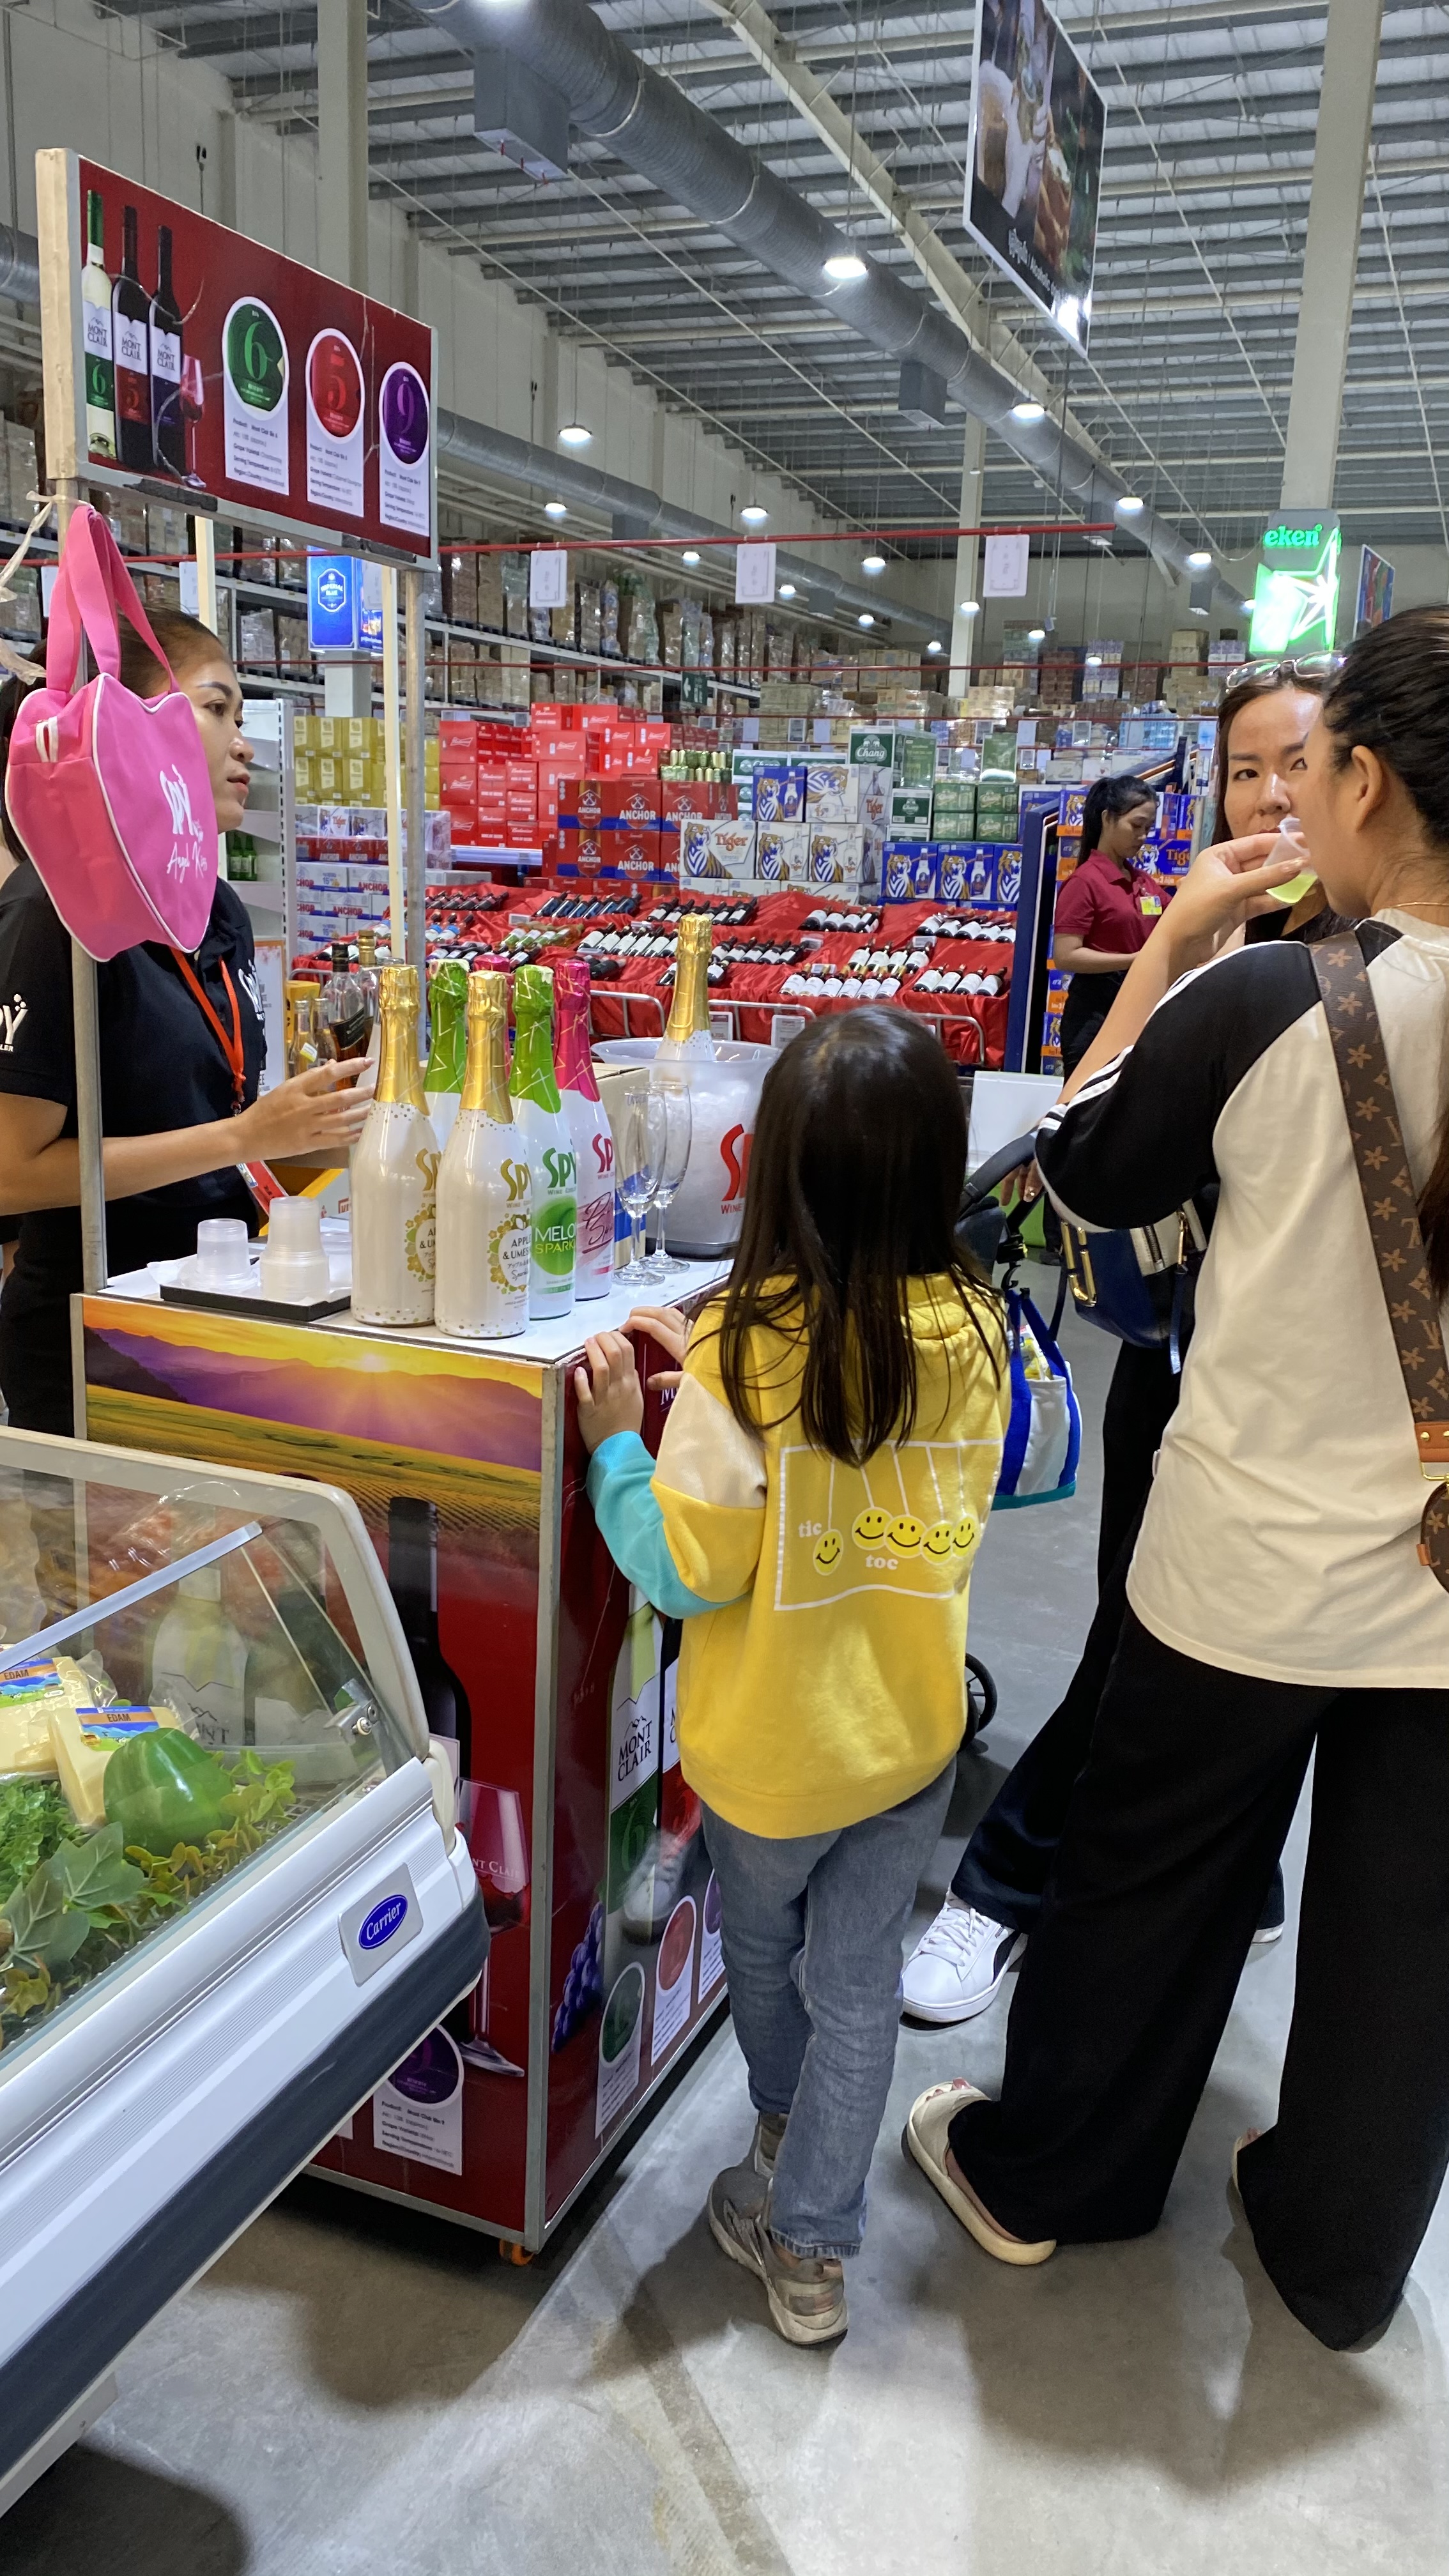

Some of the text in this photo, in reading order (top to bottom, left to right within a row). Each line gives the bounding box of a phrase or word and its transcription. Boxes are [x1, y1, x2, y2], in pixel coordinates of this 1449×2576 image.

[88, 324, 107, 339] MONT
[88, 332, 107, 347] CLAIR
[121, 337, 141, 352] MONT
[121, 346, 141, 361] CLAIR
[157, 349, 176, 362] MONT
[245, 321, 267, 381] 6
[157, 357, 176, 371] CLAIR
[92, 364, 106, 395] 6
[397, 383, 414, 434] 9
[857, 747, 885, 758] Chang
[619, 810, 656, 820] ANCHOR
[715, 832, 749, 852] Tiger
[1166, 848, 1190, 866] Tig
[617, 861, 654, 871] ANCHOR
[296, 878, 314, 887] CHOR
[358, 882, 388, 891] ANCHOR
[296, 903, 314, 912] CHOR
[333, 906, 363, 916] ANCHOR
[296, 930, 314, 939] CHOR
[592, 1133, 615, 1173] SP
[721, 1204, 743, 1215] WINE
[535, 1225, 576, 1242] MELO
[503, 1247, 528, 1260] & UMES
[535, 1242, 574, 1255] SPARK
[798, 1520, 822, 1538] tic
[866, 1554, 898, 1570] toc
[4, 1669, 29, 1680] EDAM
[107, 1713, 131, 1722] EDAM
[618, 1721, 652, 1765] MONT
[618, 1740, 652, 1781] CLAIR
[472, 1858, 486, 1869] NT
[366, 1902, 401, 1940] Carrier
